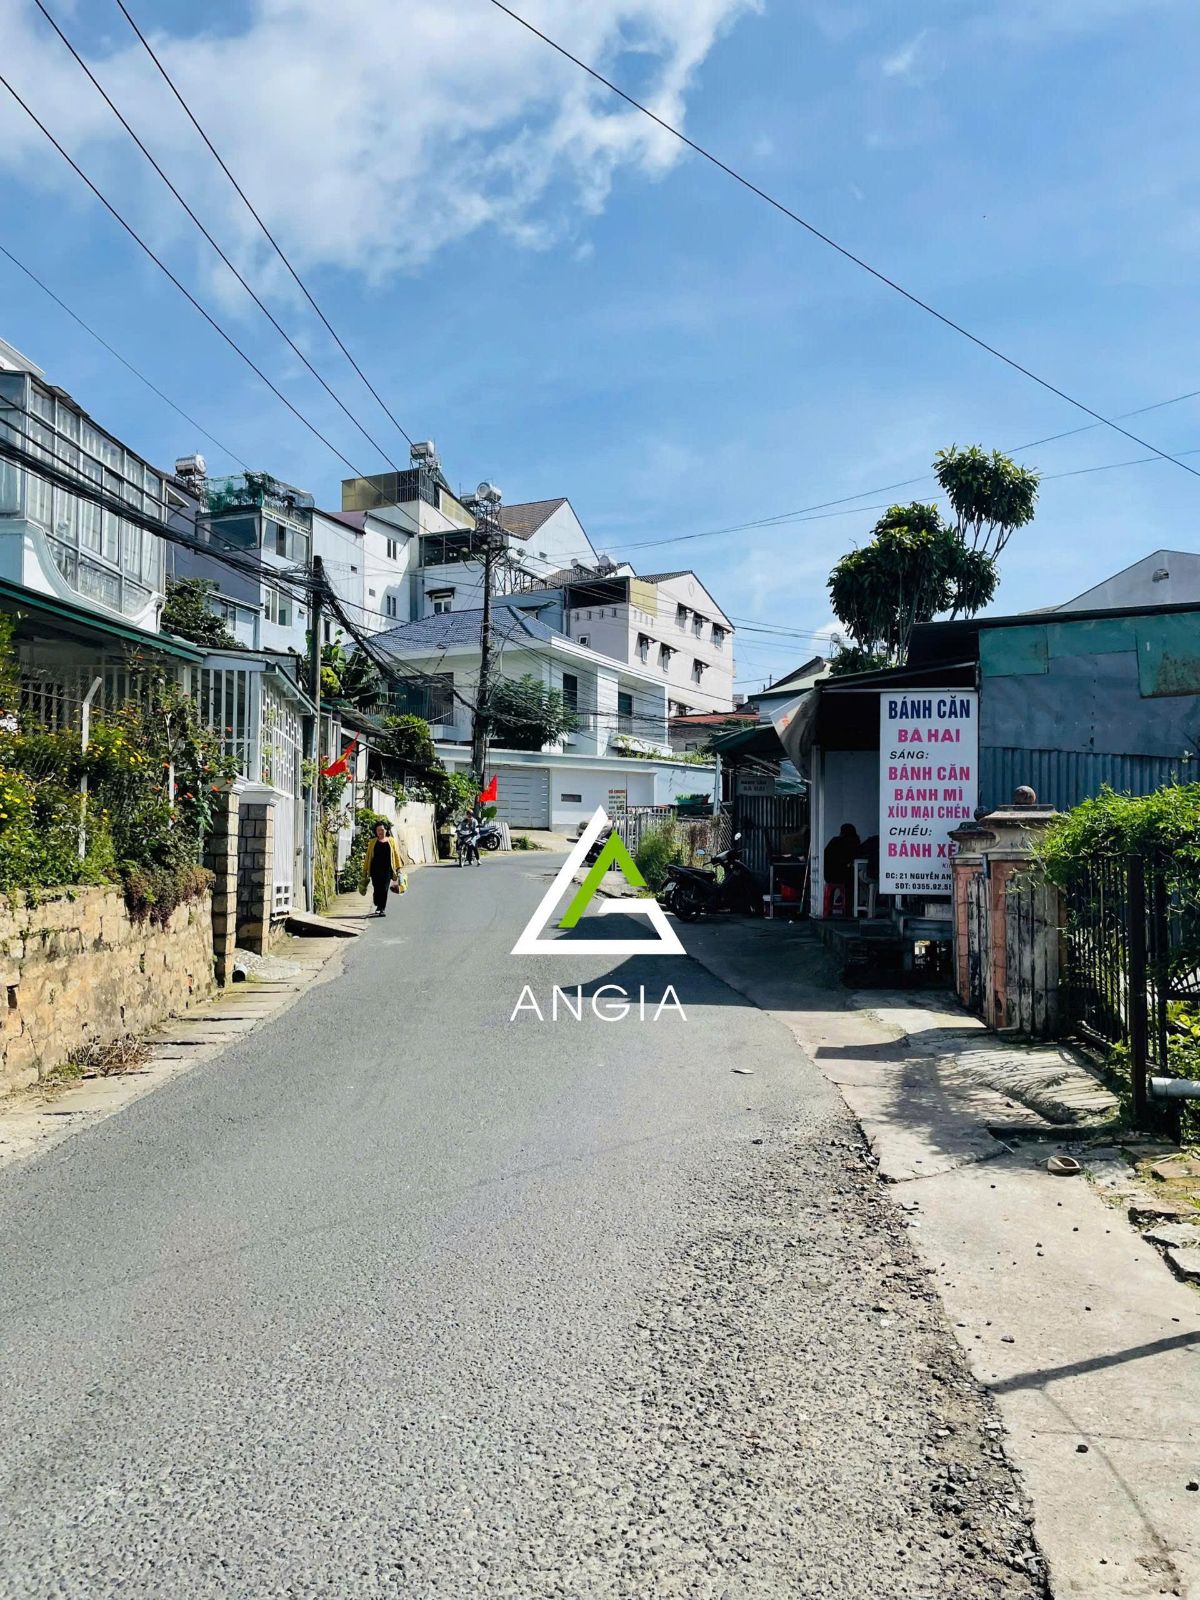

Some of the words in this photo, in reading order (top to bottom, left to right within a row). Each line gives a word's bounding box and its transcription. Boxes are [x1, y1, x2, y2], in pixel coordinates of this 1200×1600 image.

[888, 696, 932, 719] BÁNH
[937, 695, 970, 719] CĂN
[927, 729, 960, 742] HAI
[889, 749, 929, 760] SÁNG:
[888, 763, 932, 780] BÁNH
[937, 763, 970, 780] CĂN
[894, 786, 938, 801] BÁNH
[943, 786, 963, 801] MÌ
[887, 803, 908, 818] XÍU
[911, 806, 934, 821] MẠI
[937, 803, 970, 819] CHÉN
[888, 840, 932, 858] BÁNH
[899, 872, 908, 880] 21
